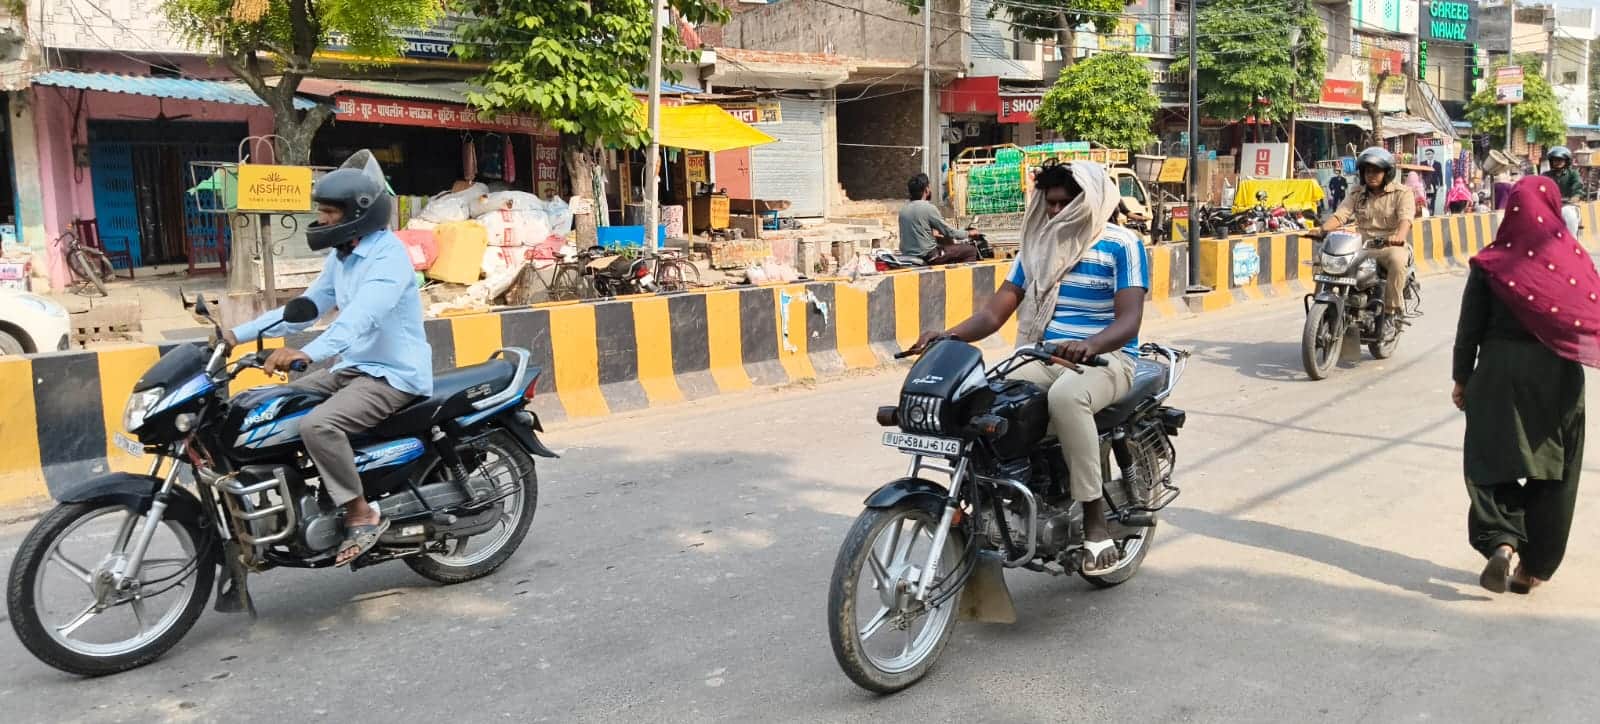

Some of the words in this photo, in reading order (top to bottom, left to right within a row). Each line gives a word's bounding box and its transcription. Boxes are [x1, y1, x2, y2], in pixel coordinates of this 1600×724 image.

[1430, 1, 1469, 20] GAREEB
[1431, 21, 1467, 40] NAWAZ
[249, 182, 301, 196] AISSHPRA
